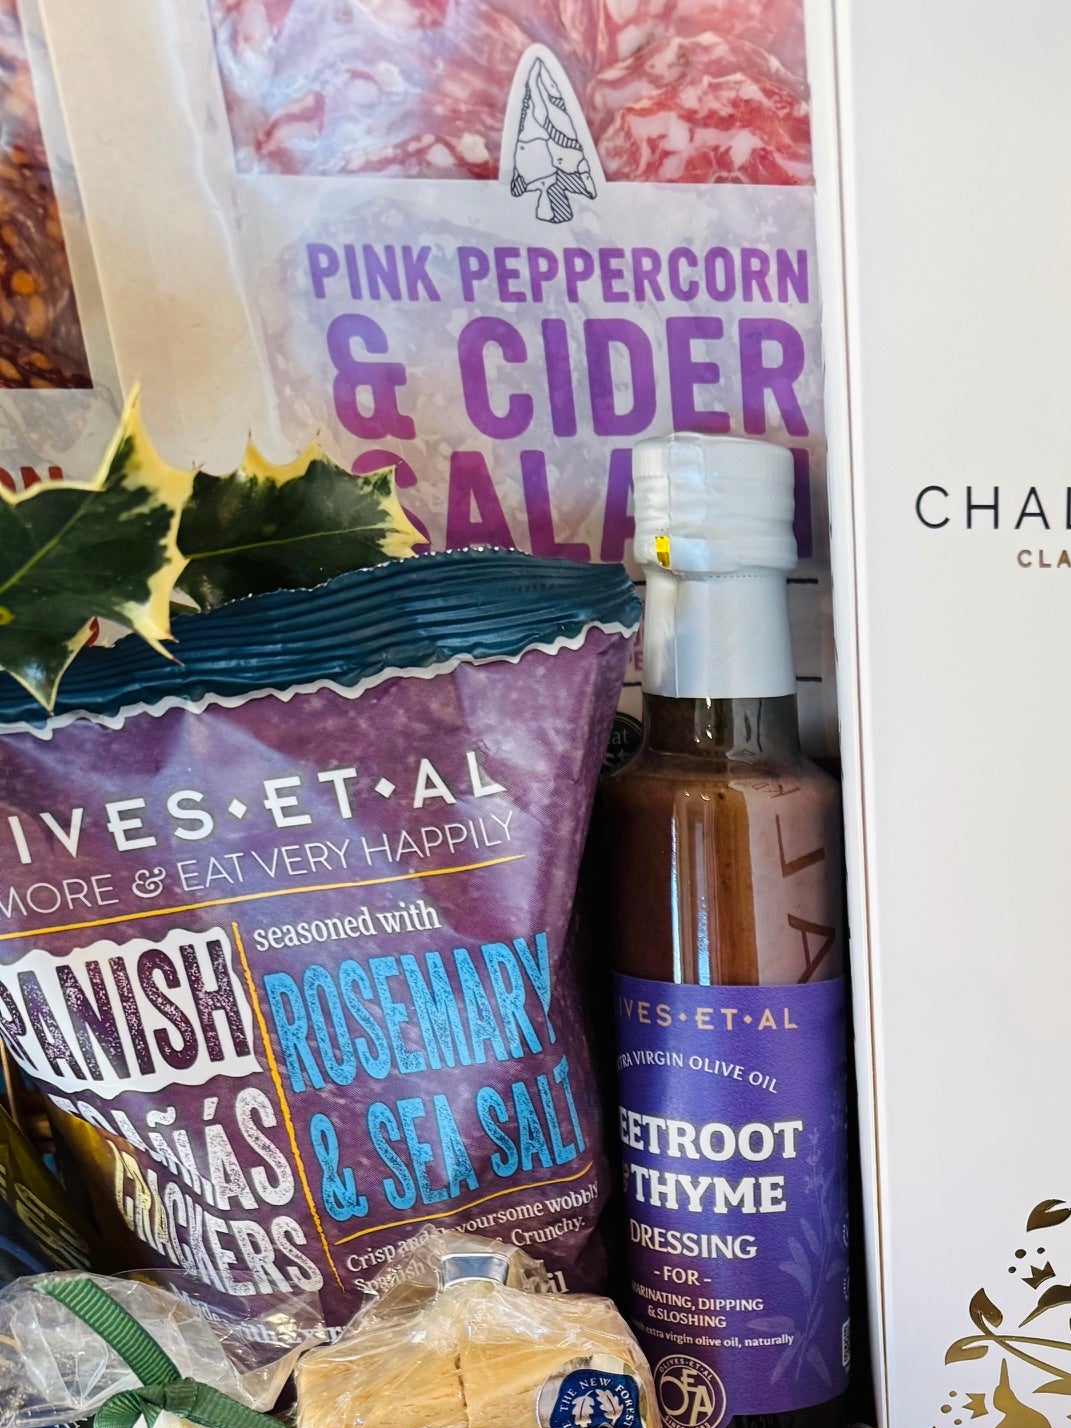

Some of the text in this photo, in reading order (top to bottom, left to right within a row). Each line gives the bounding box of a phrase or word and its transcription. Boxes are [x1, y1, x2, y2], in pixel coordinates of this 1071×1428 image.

[307, 243, 811, 305] PINK PEPPERCORN
[326, 313, 811, 441] & CIDER
[132, 811, 513, 898] & EAT VERY HAPPILY
[253, 899, 443, 952] seasoned with
[263, 931, 559, 1094] ROSEMARY
[632, 1050, 778, 1094] VIRGIN OLIVE OIL
[308, 1111, 368, 1223] &
[366, 1094, 478, 1210] SEA
[480, 1056, 588, 1178] SALT
[630, 1163, 787, 1215] THYME
[346, 1180, 599, 1273] Crisp wobbly
[512, 1215, 586, 1247] Crunchy.
[629, 1218, 758, 1260] DRESSING
[663, 1266, 701, 1286] FOR
[698, 1297, 764, 1311] DIPPING
[664, 1330, 795, 1349] virgin olive oil, naturally
[560, 1387, 576, 1413] THE
[579, 1376, 612, 1390] NEW
